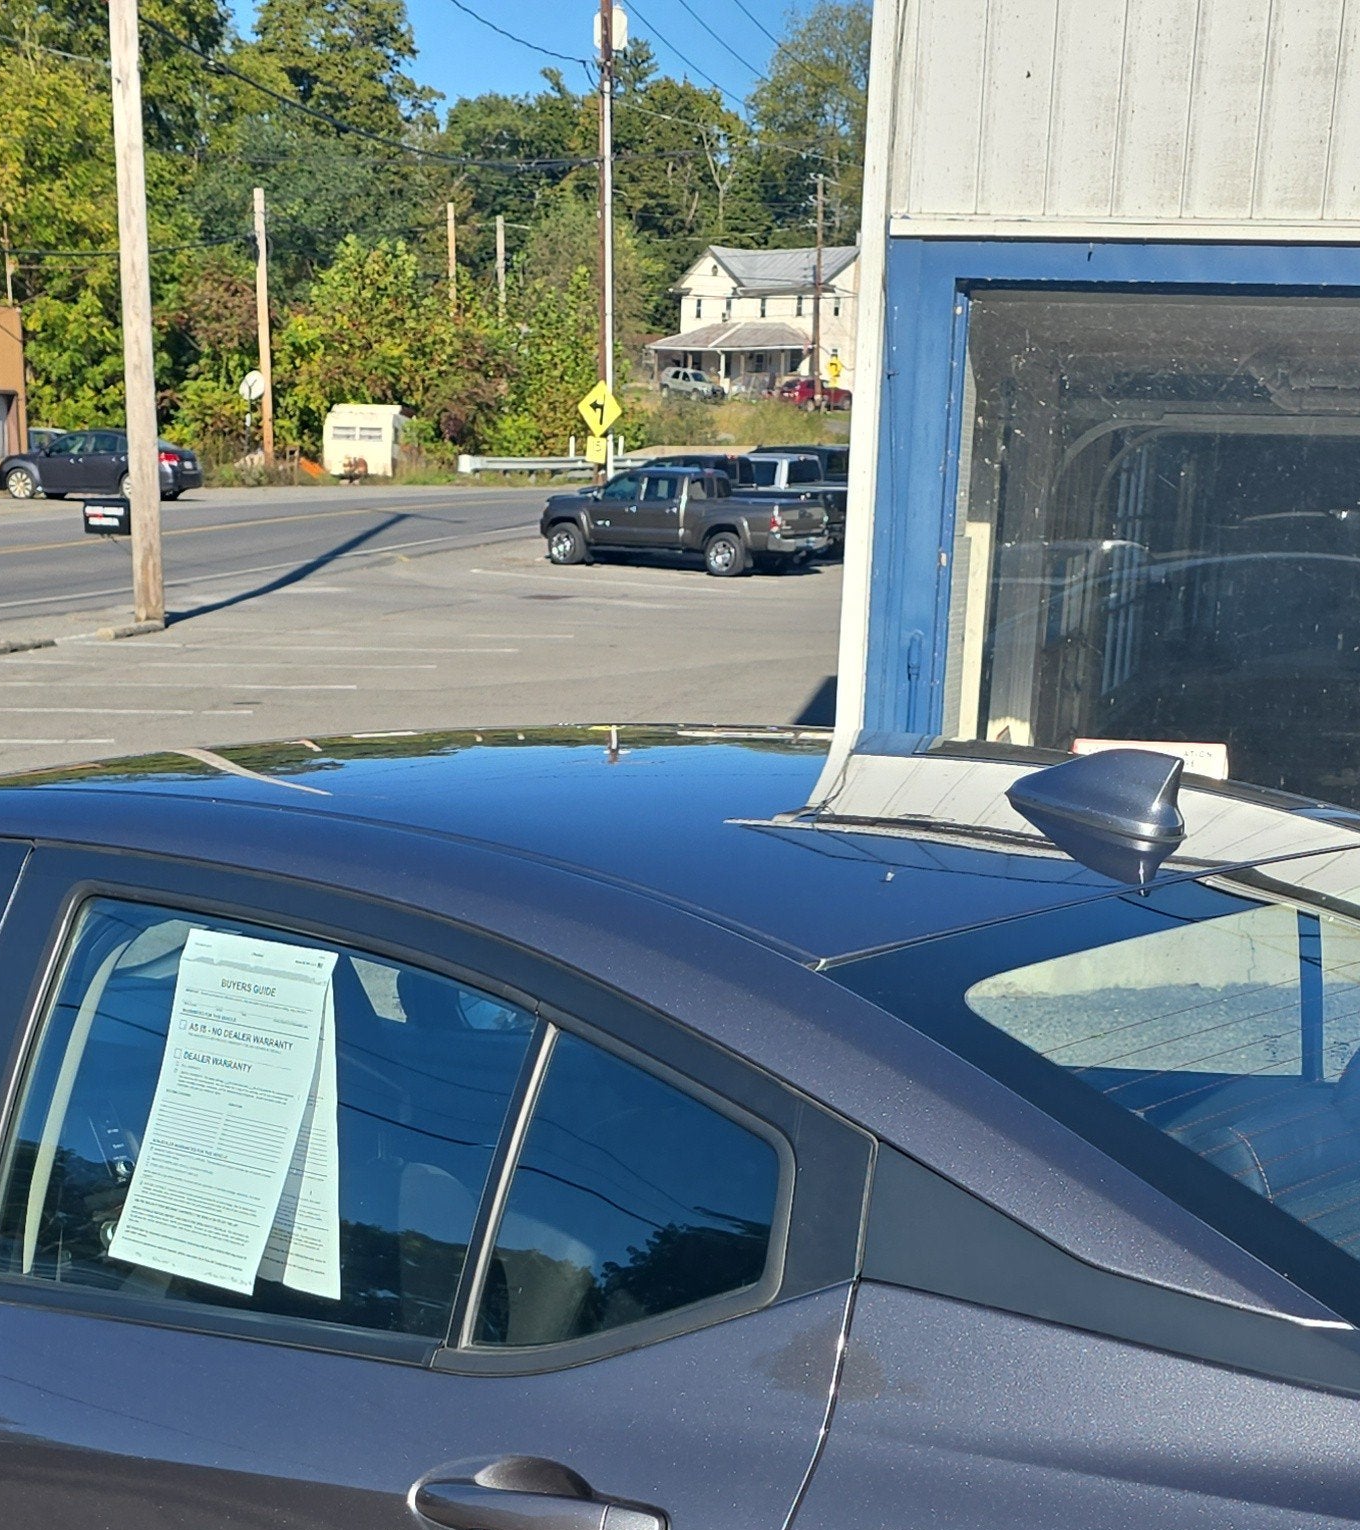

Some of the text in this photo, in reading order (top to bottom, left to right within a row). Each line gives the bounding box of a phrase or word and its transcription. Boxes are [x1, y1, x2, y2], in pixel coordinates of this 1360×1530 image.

[221, 978, 277, 997] BUYERS GUIDE
[189, 1023, 199, 1033] AS
[199, 1023, 207, 1034] IS
[212, 1027, 223, 1037] NO
[223, 1029, 252, 1043] DEALER
[253, 1036, 294, 1051] WARRANTY
[183, 1051, 212, 1064] DEALER
[212, 1056, 253, 1073] WARRANTY
